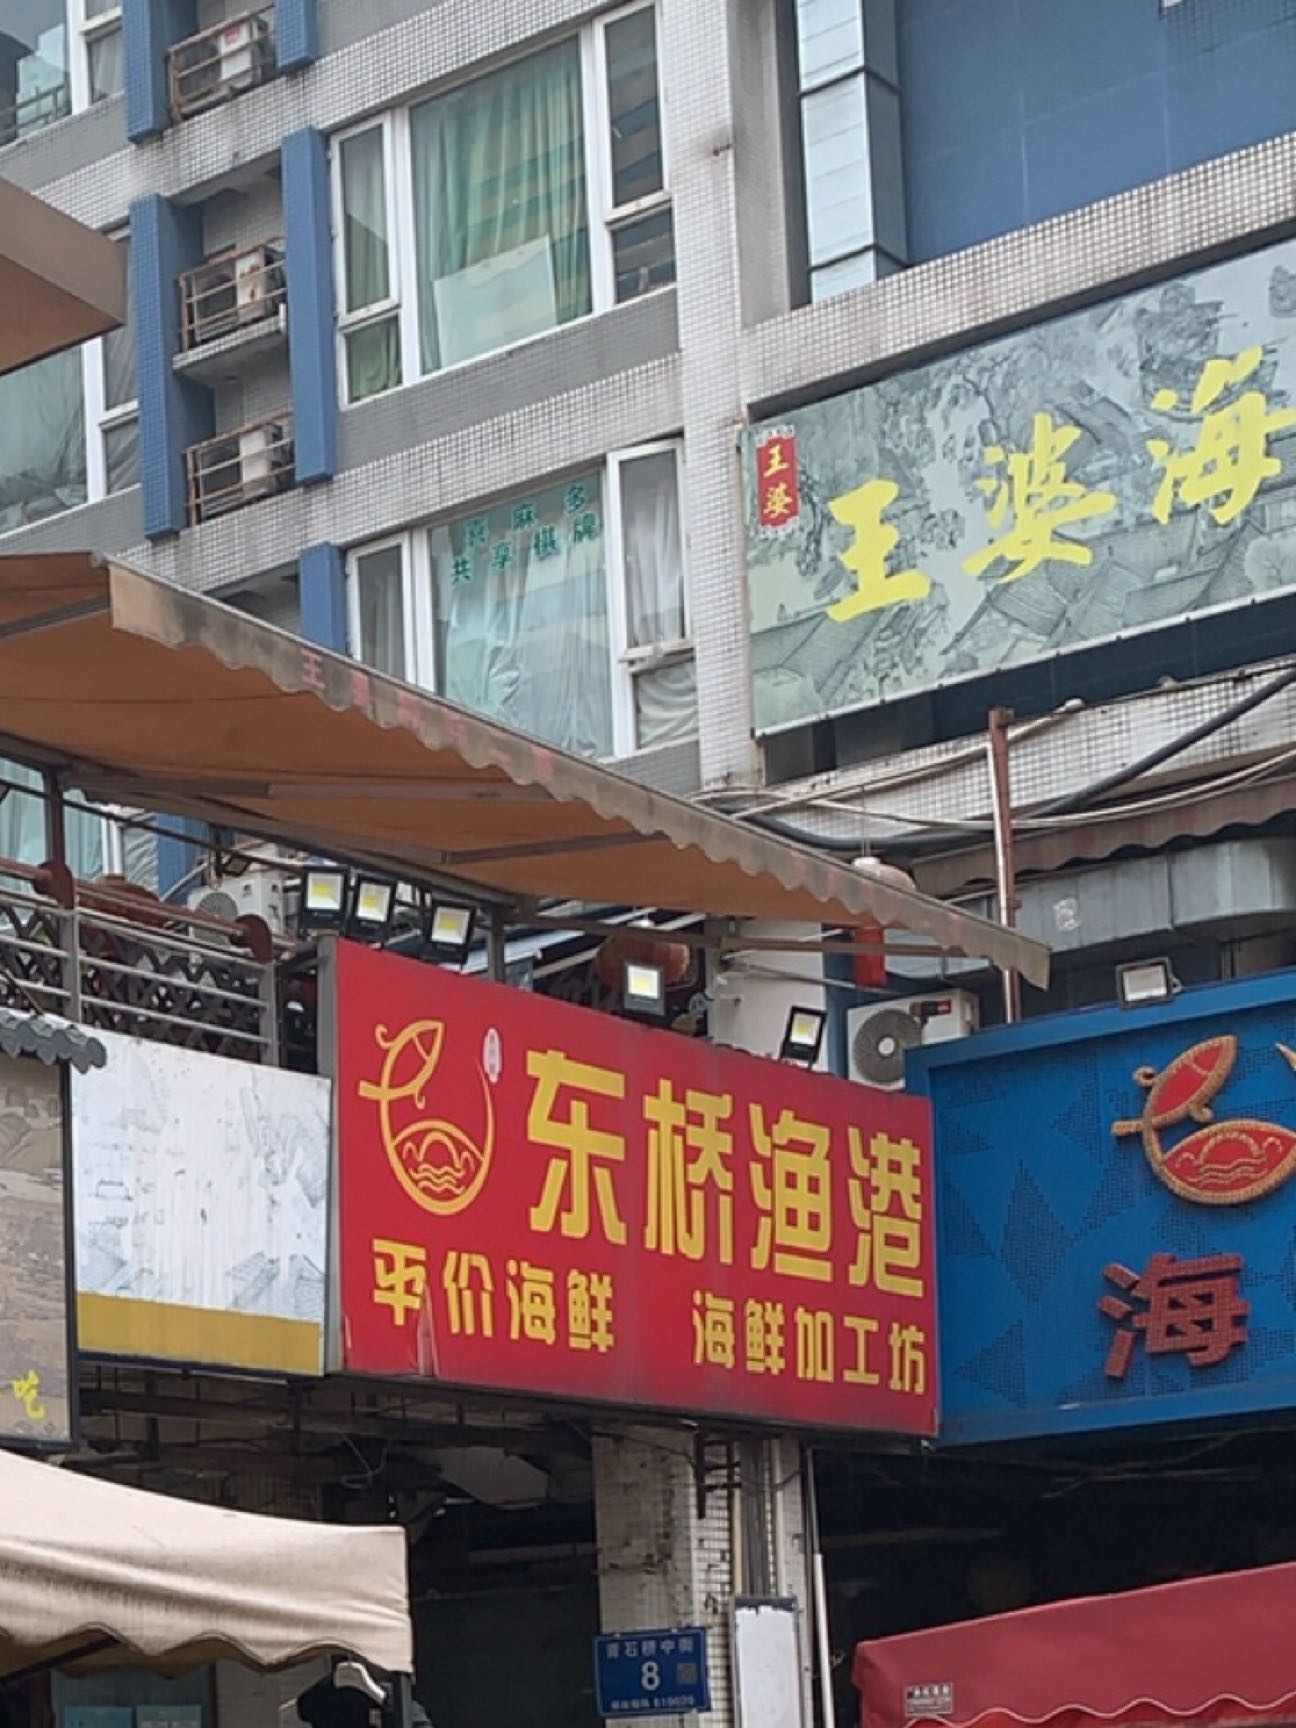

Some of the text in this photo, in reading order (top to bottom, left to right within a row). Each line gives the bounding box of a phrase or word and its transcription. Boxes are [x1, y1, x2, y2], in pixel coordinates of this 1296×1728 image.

[826, 345, 1296, 622] 王婆海
[526, 1049, 925, 1299] 东桥渔港
[372, 1237, 926, 1396] 平价海鲜 海鲜加工坊
[1097, 1252, 1252, 1381] 海
[641, 1661, 661, 1691] 8
